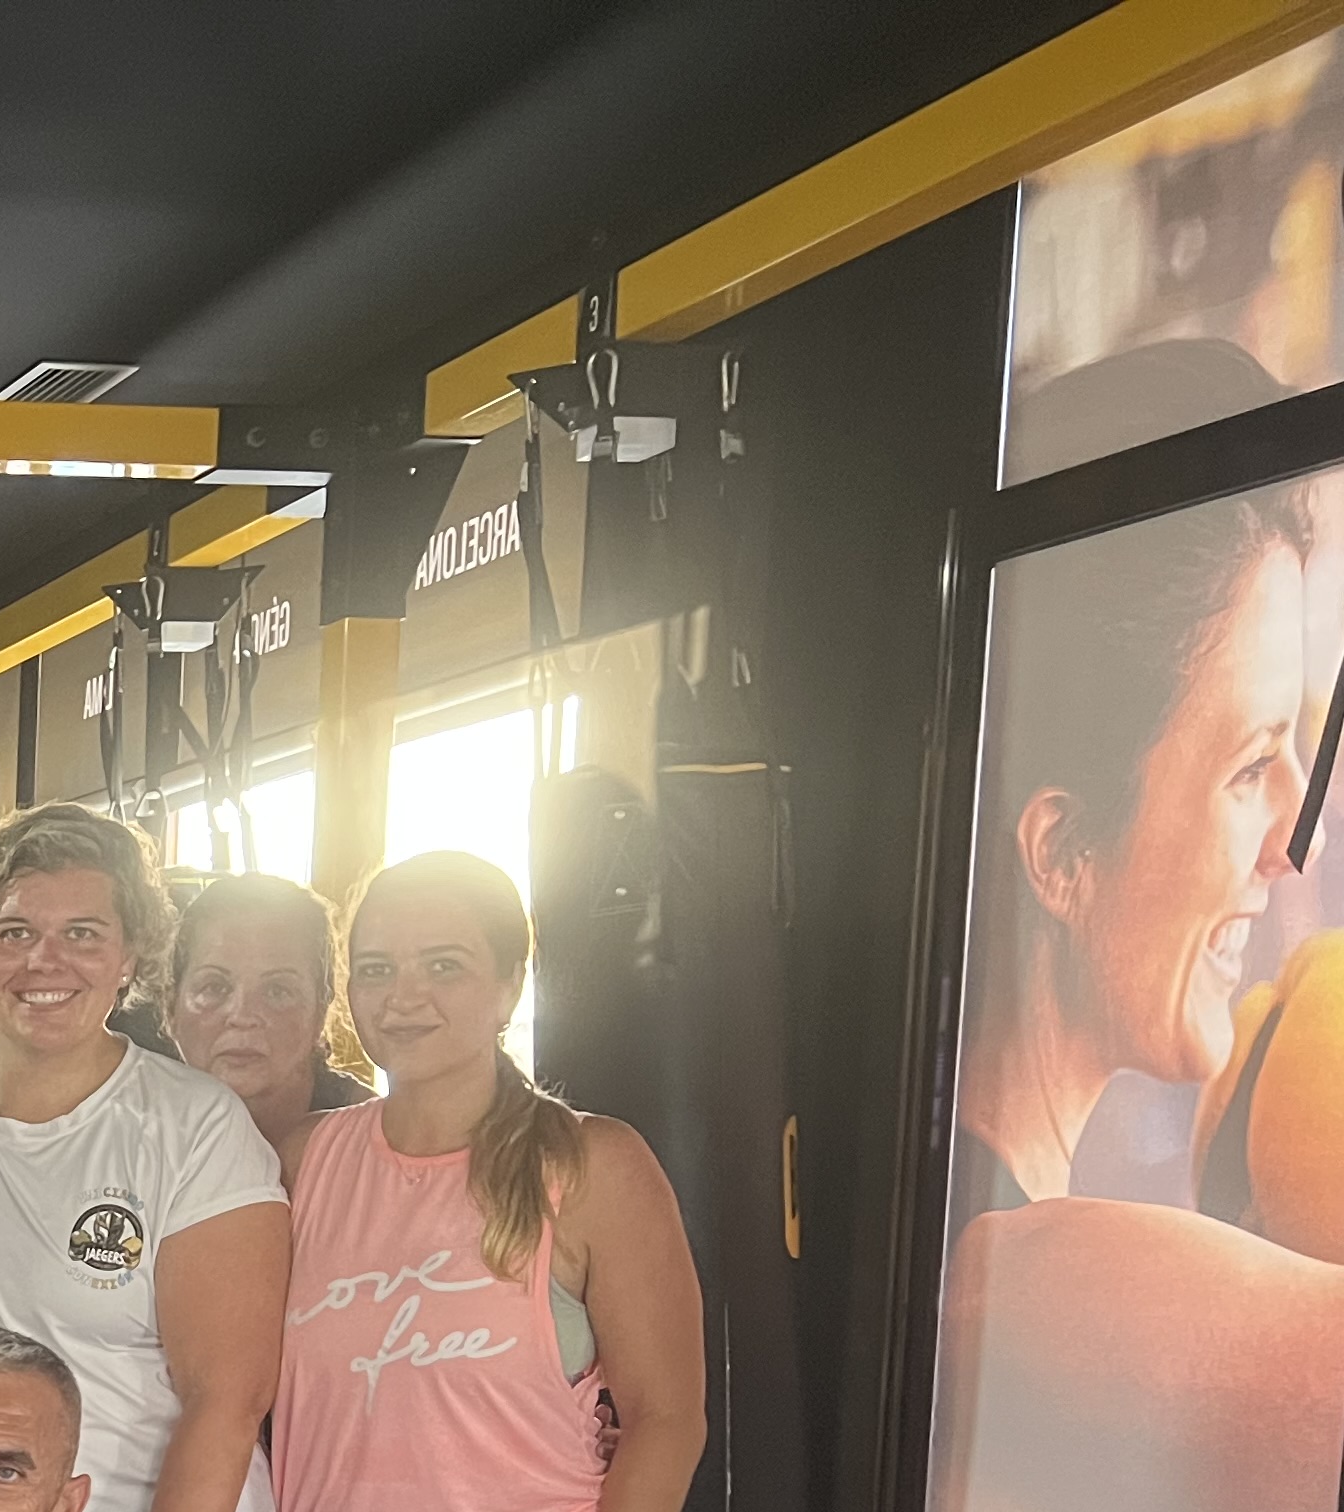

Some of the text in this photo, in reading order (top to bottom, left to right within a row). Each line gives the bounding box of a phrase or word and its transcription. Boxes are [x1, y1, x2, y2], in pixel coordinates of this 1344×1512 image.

[83, 1246, 127, 1265] JAEGERS
[286, 1249, 496, 1326] ove
[350, 1294, 518, 1416] free
